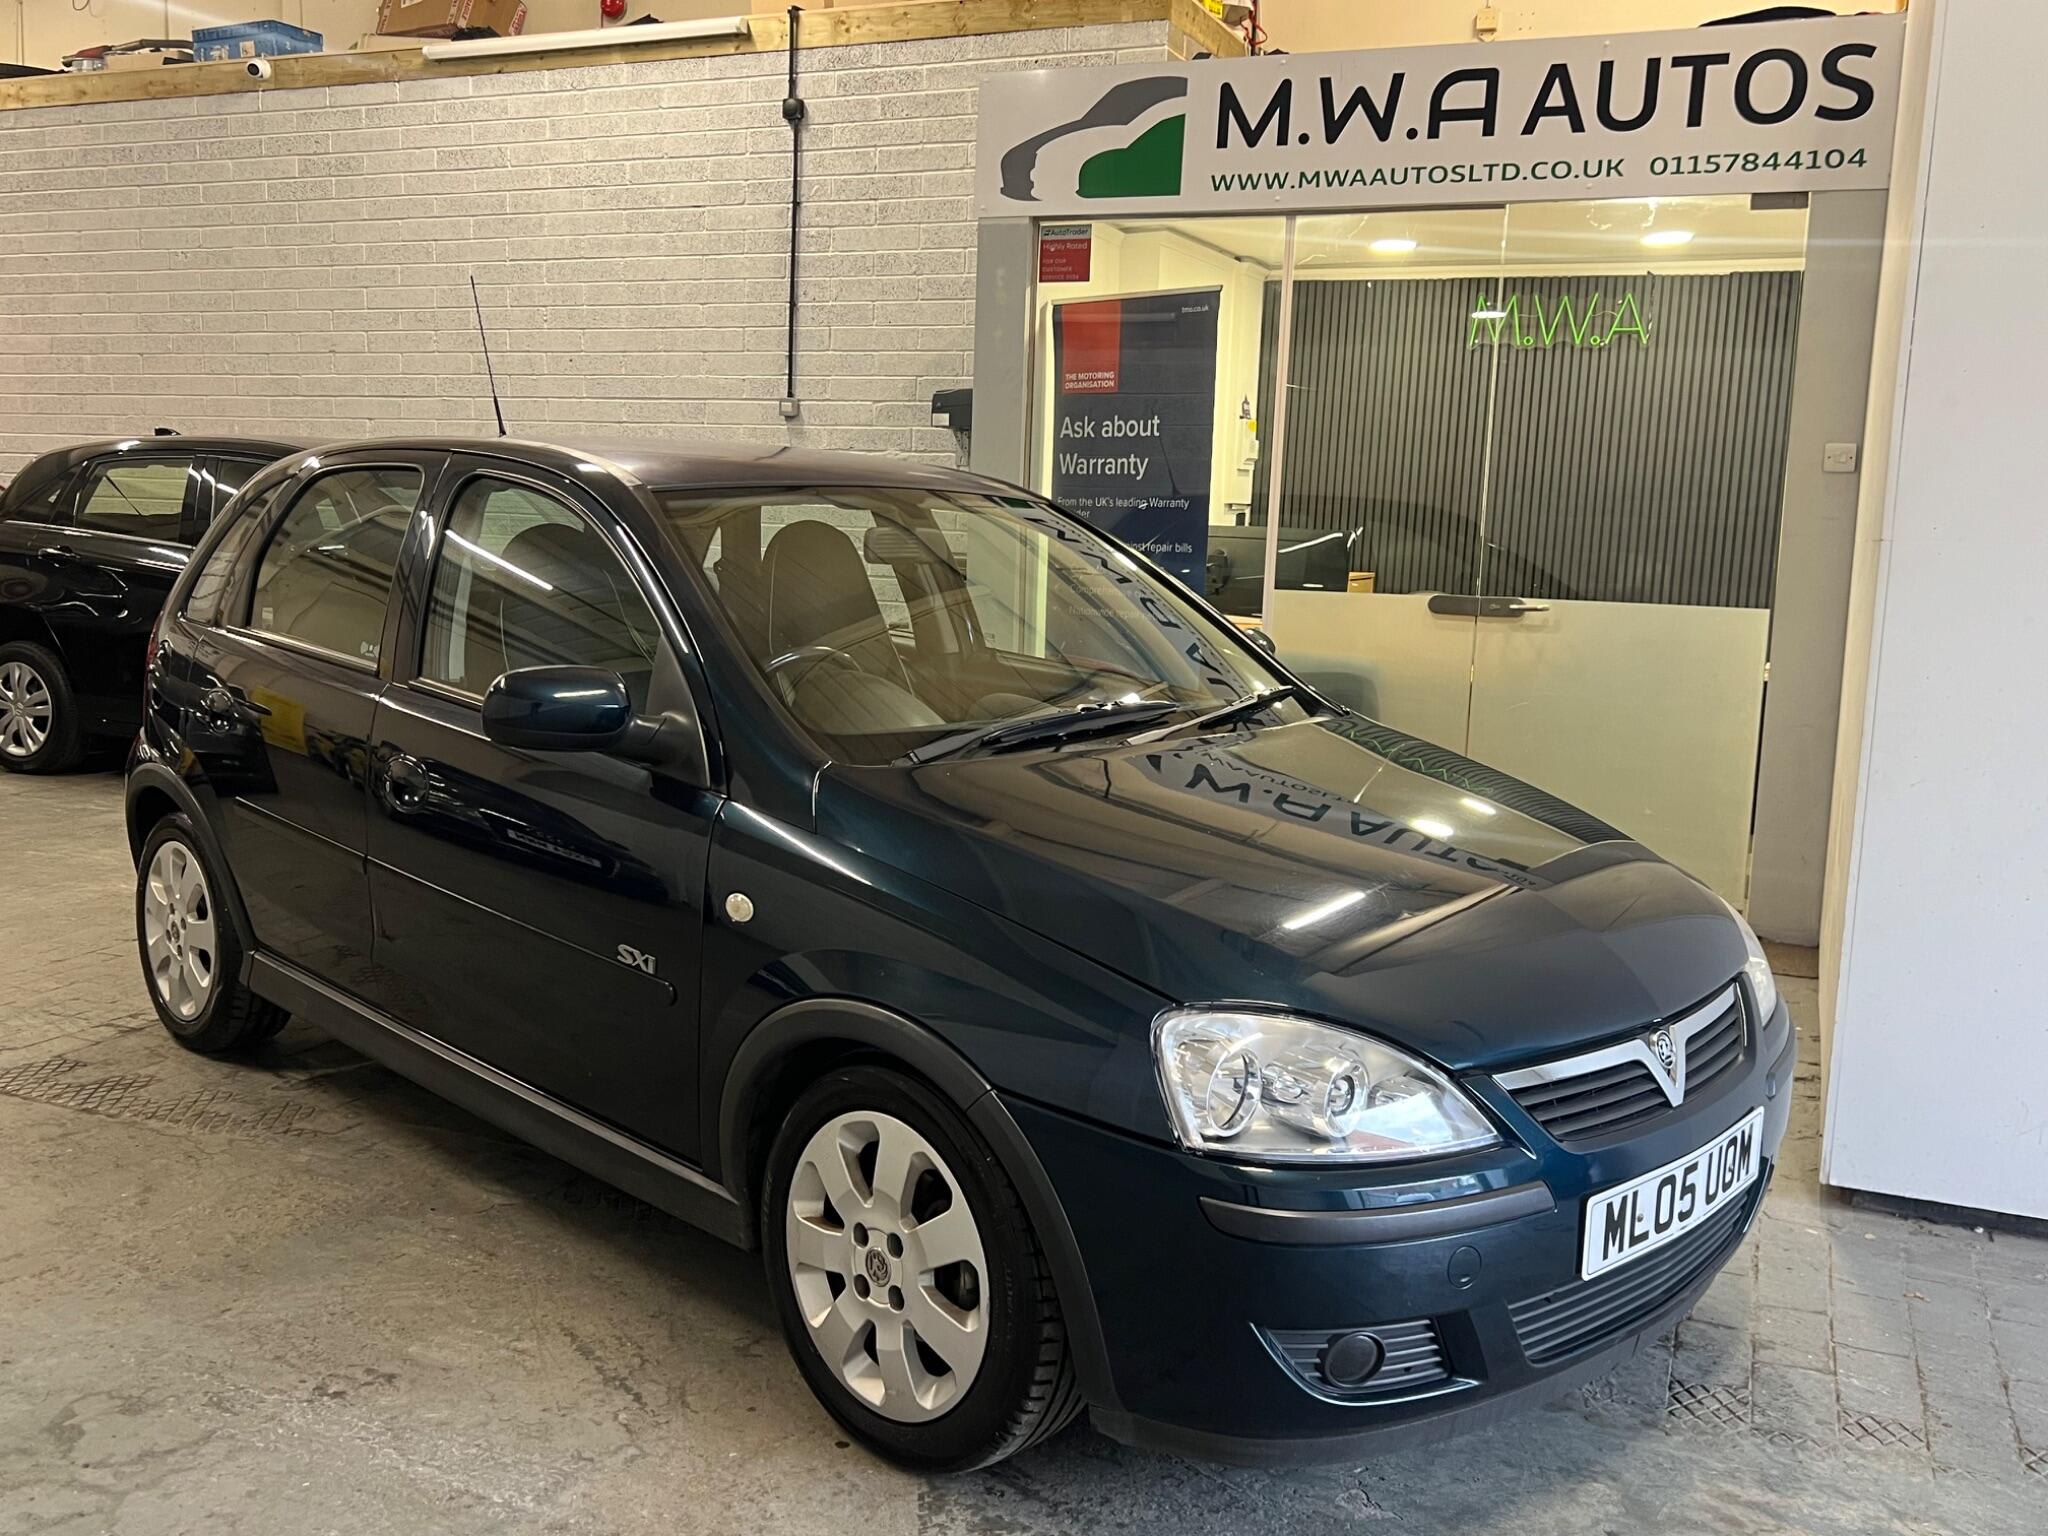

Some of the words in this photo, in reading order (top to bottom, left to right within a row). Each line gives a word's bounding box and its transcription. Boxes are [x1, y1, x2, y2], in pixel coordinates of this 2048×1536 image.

[1520, 43, 1877, 137] AUTOS
[1211, 158, 1625, 192] WWW.MWAAUTOSLTD.CO.UK
[1649, 147, 1867, 176] 01157844104
[1066, 240, 1088, 250] Rated
[1065, 373, 1078, 381] THE
[1078, 371, 1115, 380] MOTORING
[1065, 380, 1115, 390] ORGANISATION
[1060, 416, 1096, 438] Ask
[1101, 414, 1161, 437] about
[1059, 452, 1149, 480] Warranty
[1058, 497, 1077, 506] From
[1079, 497, 1093, 507] the
[1095, 497, 1114, 507] UK's
[1115, 497, 1148, 510] leading
[1149, 497, 1190, 511] Warranty
[1148, 541, 1173, 554] repair
[1174, 540, 1193, 553] bills
[1602, 1160, 1699, 1261] ML05
[1704, 1121, 1754, 1206] UOM
